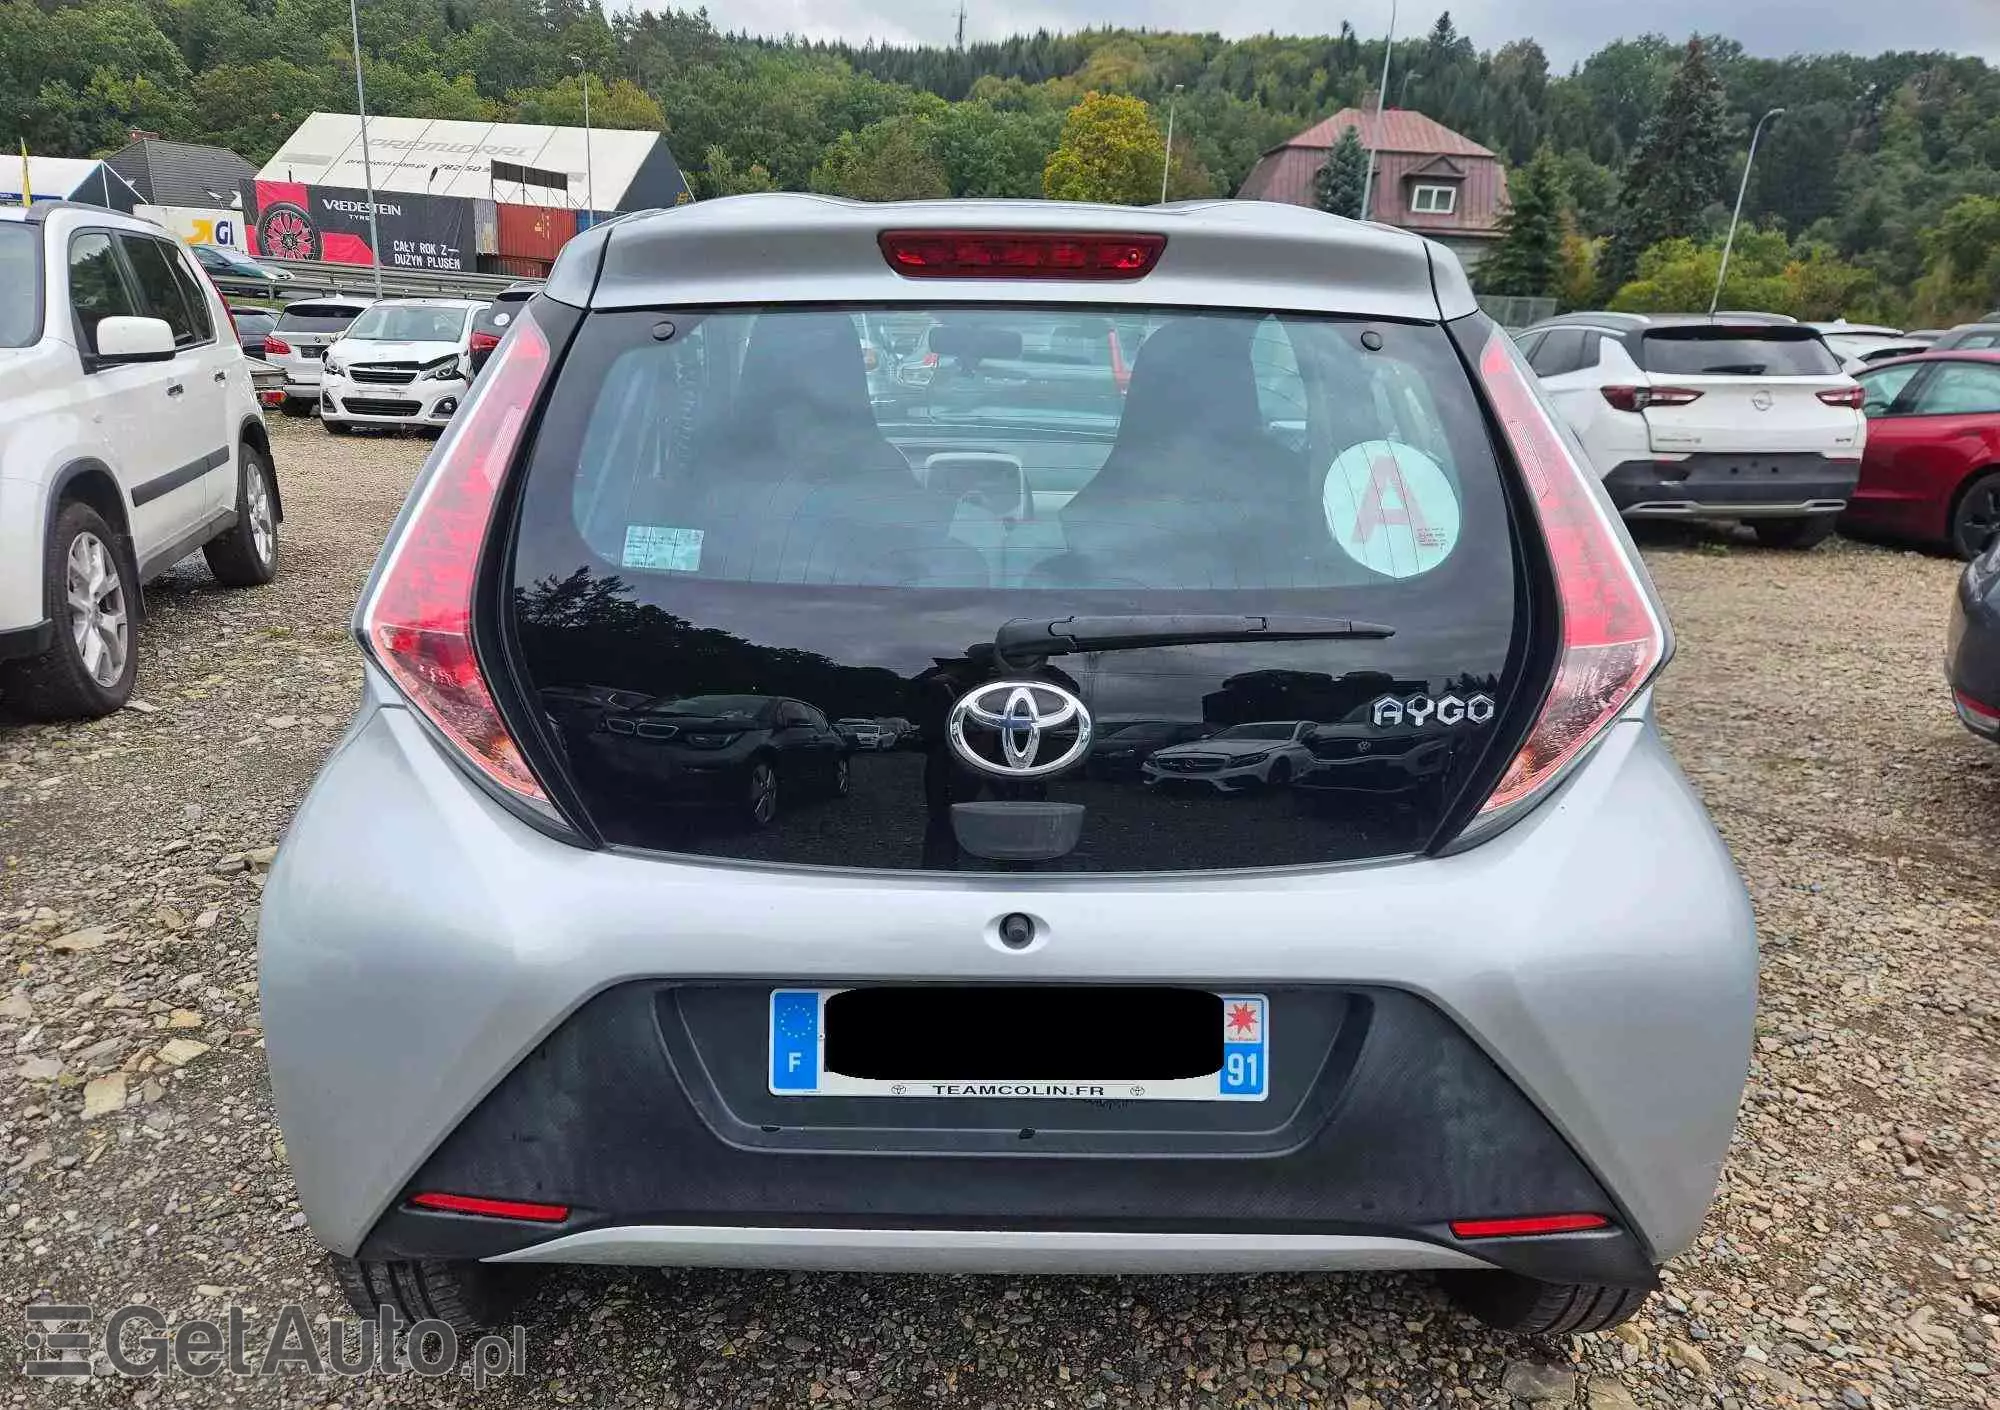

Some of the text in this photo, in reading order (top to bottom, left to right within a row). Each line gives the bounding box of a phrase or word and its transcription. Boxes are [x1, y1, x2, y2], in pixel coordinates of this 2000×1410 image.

[393, 240, 415, 253] CAŁY
[420, 242, 436, 254] ROK
[1352, 455, 1435, 548] A
[1374, 694, 1496, 727] AYGO
[788, 1052, 802, 1073] F
[1227, 1052, 1257, 1087] 91
[932, 1085, 1104, 1096] TEAMCOLIN.FR
